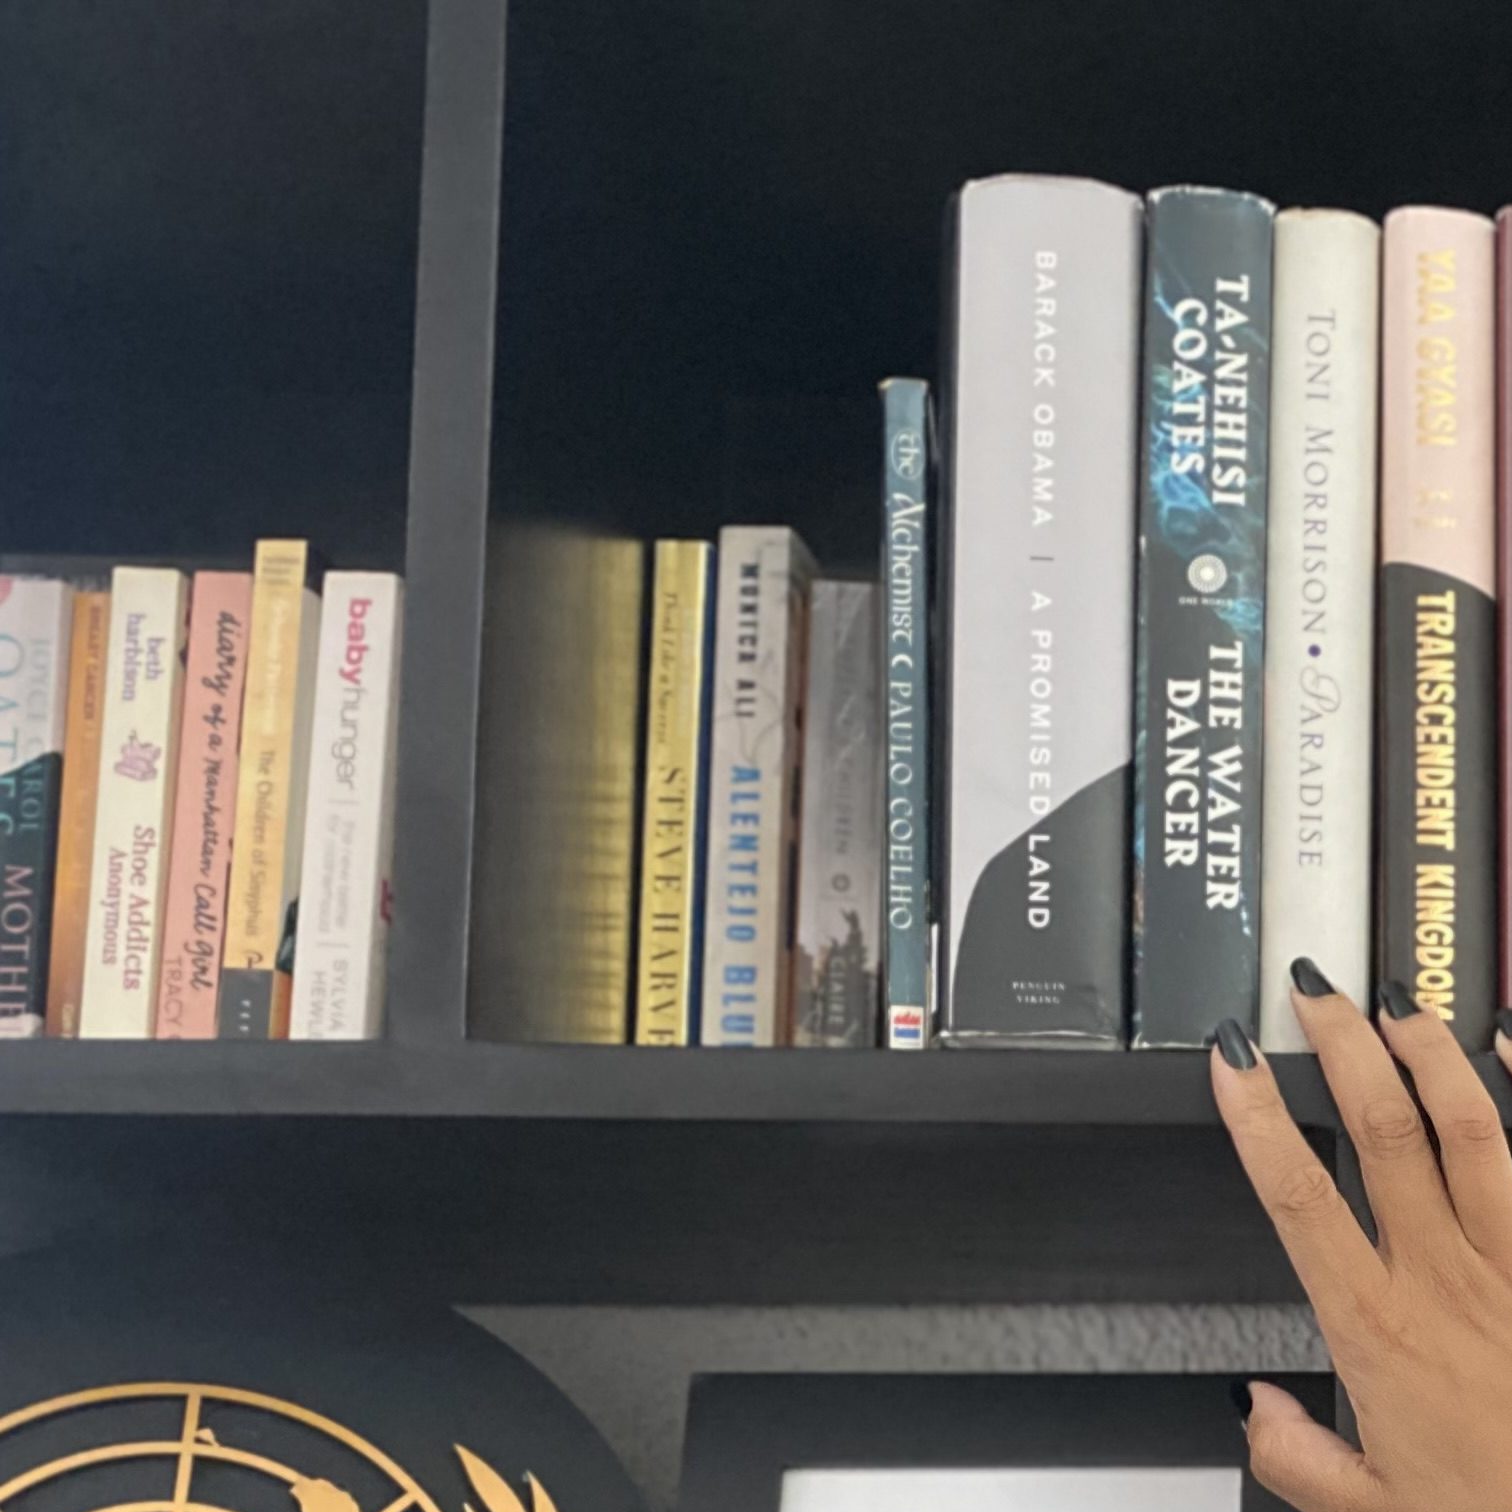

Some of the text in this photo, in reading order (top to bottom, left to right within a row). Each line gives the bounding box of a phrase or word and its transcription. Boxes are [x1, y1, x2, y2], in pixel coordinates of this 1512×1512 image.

[1032, 251, 1057, 527] BARACK OBAMA
[1170, 298, 1208, 476] COATES
[1211, 275, 1250, 506] TA-NEHISI
[735, 564, 760, 718] MONICA ALI
[892, 493, 926, 645] Alchemist
[1298, 309, 1342, 869] TONI MORRISON PARADISE
[202, 611, 241, 696] diary
[208, 704, 225, 728] of
[1415, 590, 1456, 852] TRANSCENDENT
[208, 733, 222, 750] a
[251, 780, 275, 845] Children
[258, 750, 277, 775] The
[888, 681, 914, 931] PAULO COELHO
[1027, 591, 1053, 929] A PROMISED LAND
[1163, 678, 1201, 868] DANCER
[1206, 641, 1244, 910] THE WATER
[102, 847, 126, 965] Anonymous
[652, 766, 685, 895] STEVE
[722, 766, 761, 1048] ALENTEJO BLU
[124, 825, 154, 991] Shoe Addicts
[192, 884, 218, 935] Call
[162, 955, 184, 1026] TRACY
[308, 970, 328, 1040] HEWL
[328, 959, 350, 1032] SYLVIA
